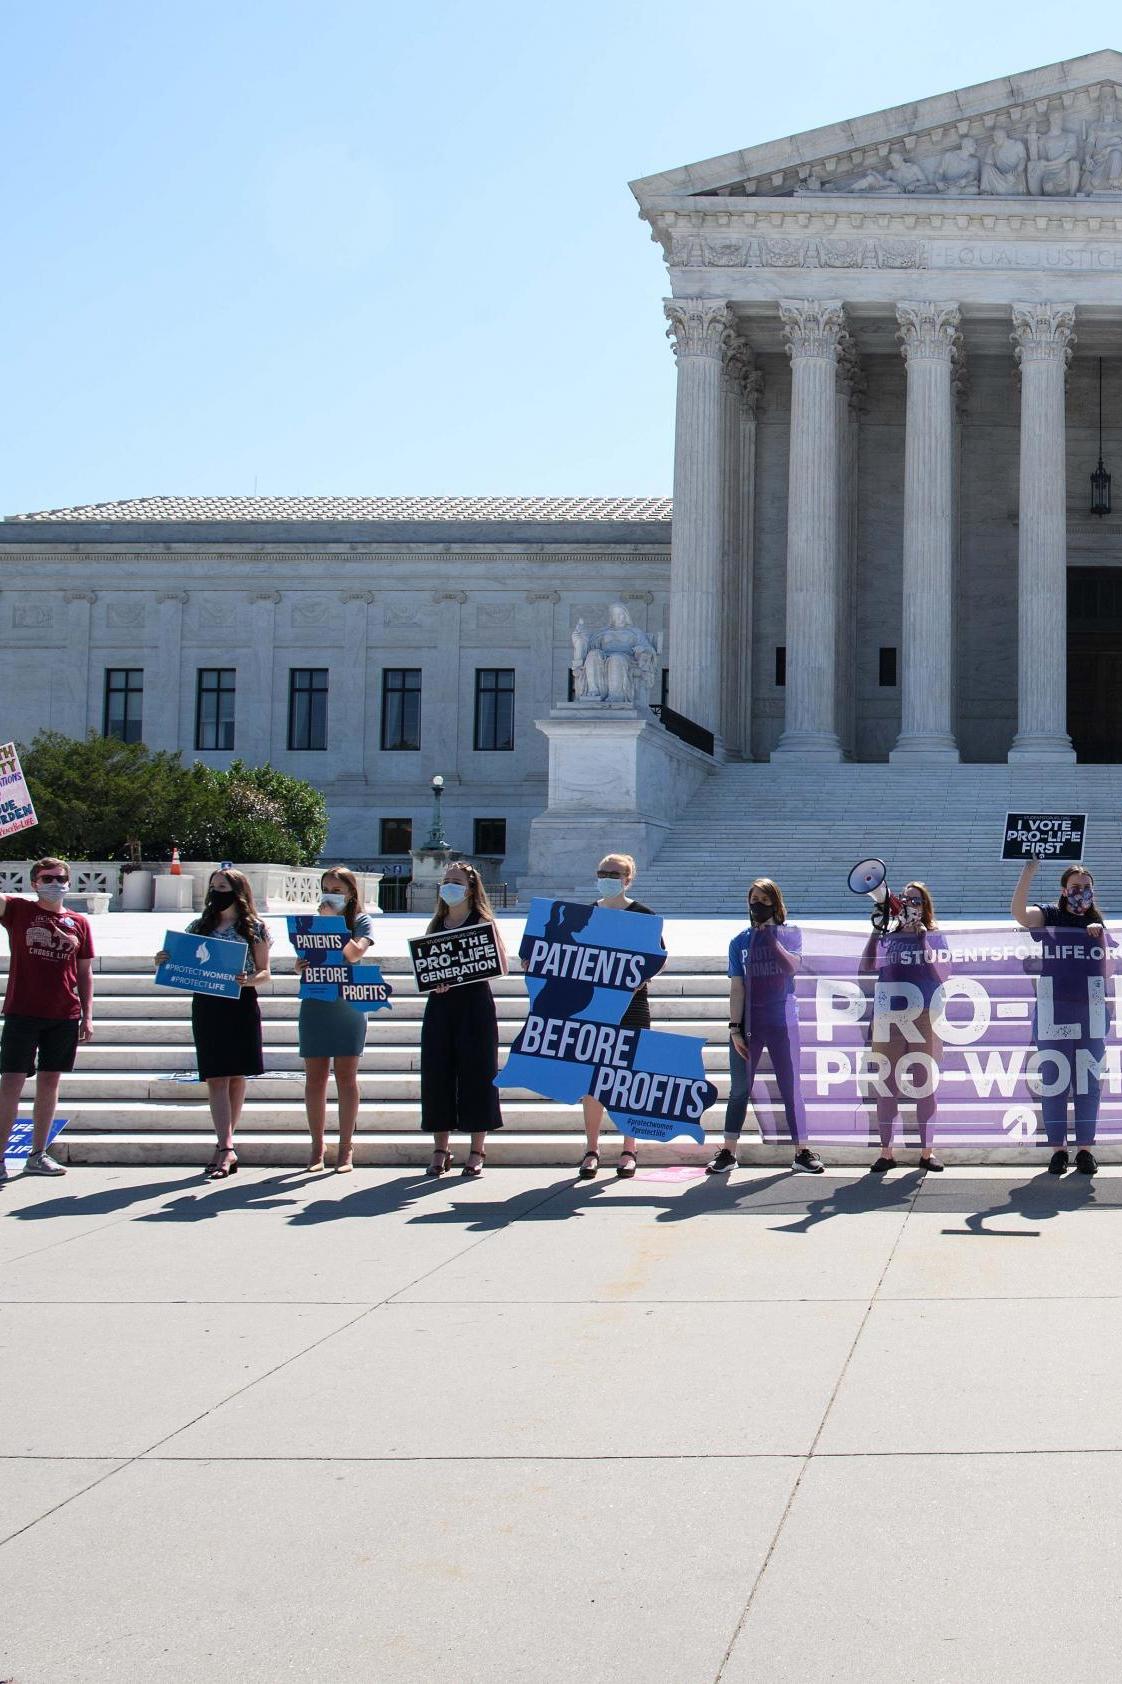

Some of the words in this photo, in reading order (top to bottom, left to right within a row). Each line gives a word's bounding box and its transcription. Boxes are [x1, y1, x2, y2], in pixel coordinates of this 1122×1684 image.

[944, 247, 1024, 266] EQUAL
[1033, 248, 1122, 267] JUSTICE
[1017, 820, 1023, 830] I
[1029, 820, 1072, 830] VOTE
[1006, 830, 1081, 842] PRO-LIFE
[1021, 842, 1064, 854] FIRST
[296, 934, 342, 949] PATIENTS
[417, 948, 423, 957] I
[430, 941, 453, 955] AM
[459, 934, 489, 948] THE
[29, 947, 54, 958] CHOOSE
[415, 944, 496, 972] PRO-LIFE
[165, 963, 236, 981] #PROTECTWOMEN
[420, 958, 497, 983] GENERATION
[527, 939, 646, 989] PATIENTS
[170, 976, 226, 991] #PROTECTLIFE
[305, 967, 349, 983] BEFORE
[342, 985, 387, 1000] PROFITS
[520, 1015, 635, 1067] BEFORE
[593, 1066, 708, 1119] PROFITS
